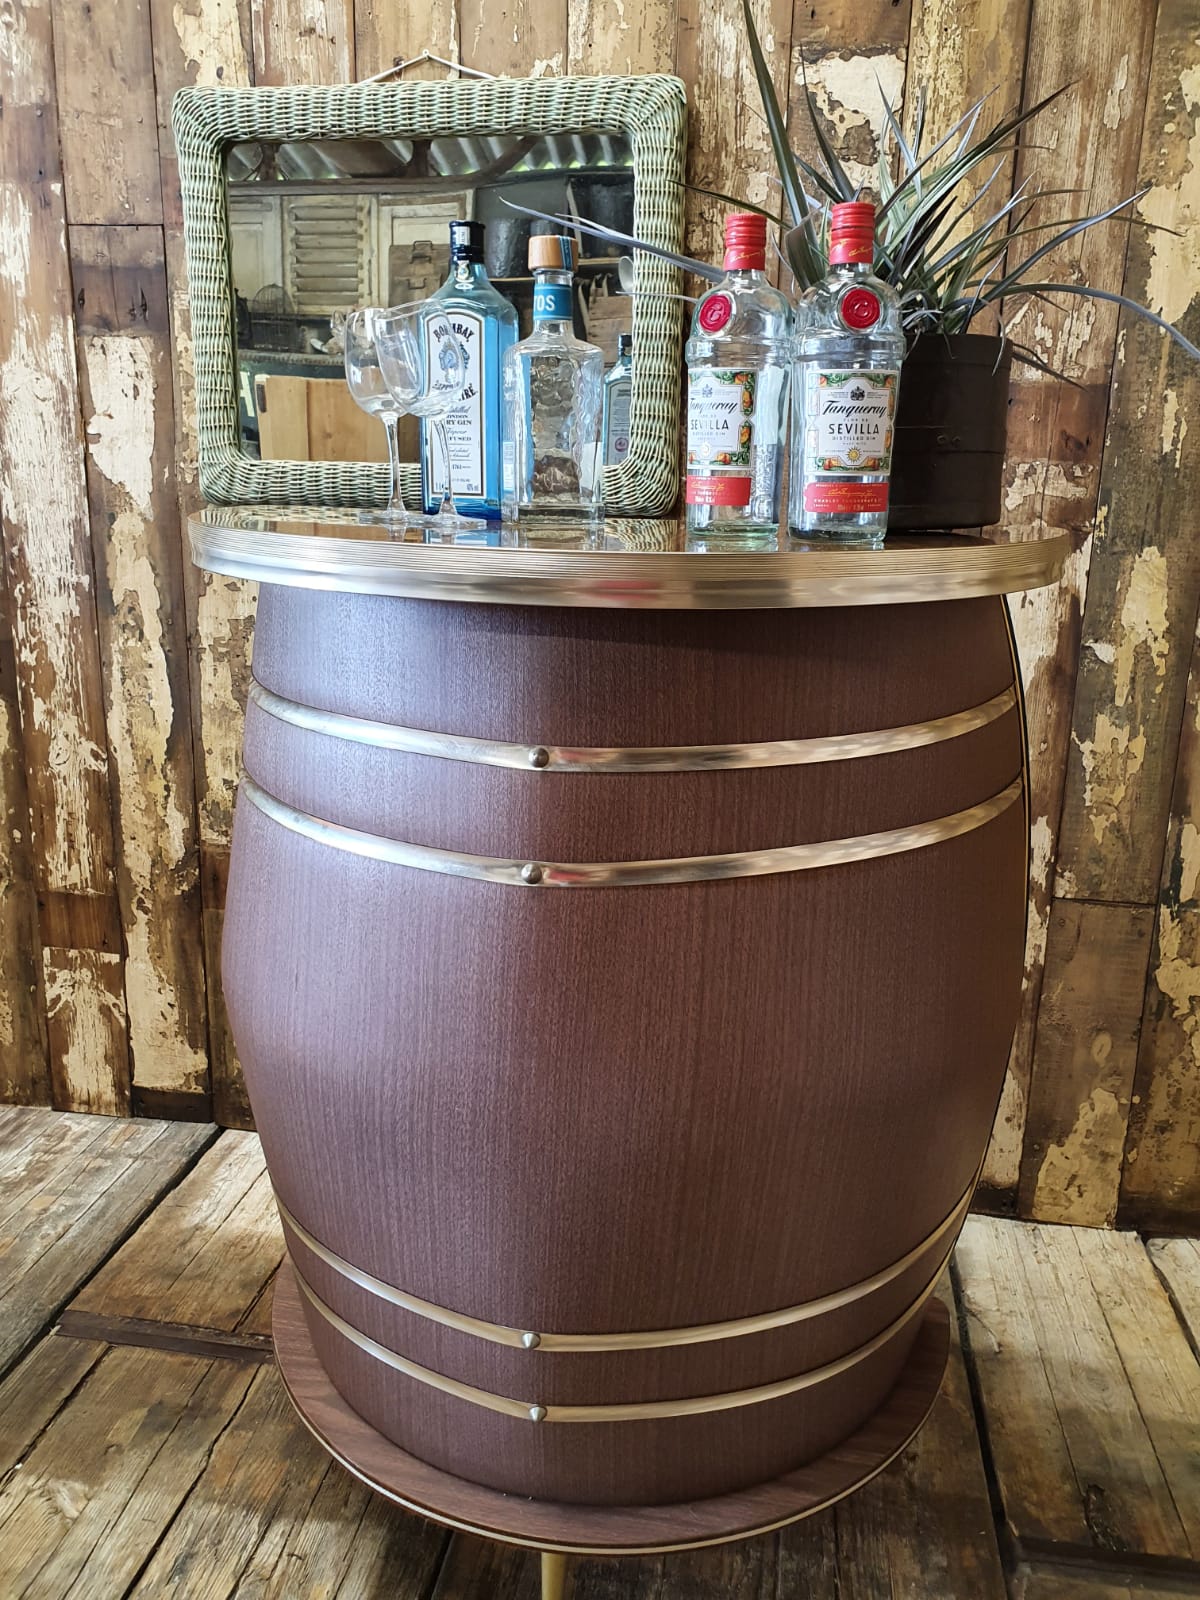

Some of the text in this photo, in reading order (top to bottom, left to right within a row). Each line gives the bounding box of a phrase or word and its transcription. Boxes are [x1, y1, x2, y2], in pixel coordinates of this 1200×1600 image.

[822, 399, 887, 418] Tanqueray
[690, 418, 729, 430] SEVILLA
[828, 423, 879, 434] SEVILLA
